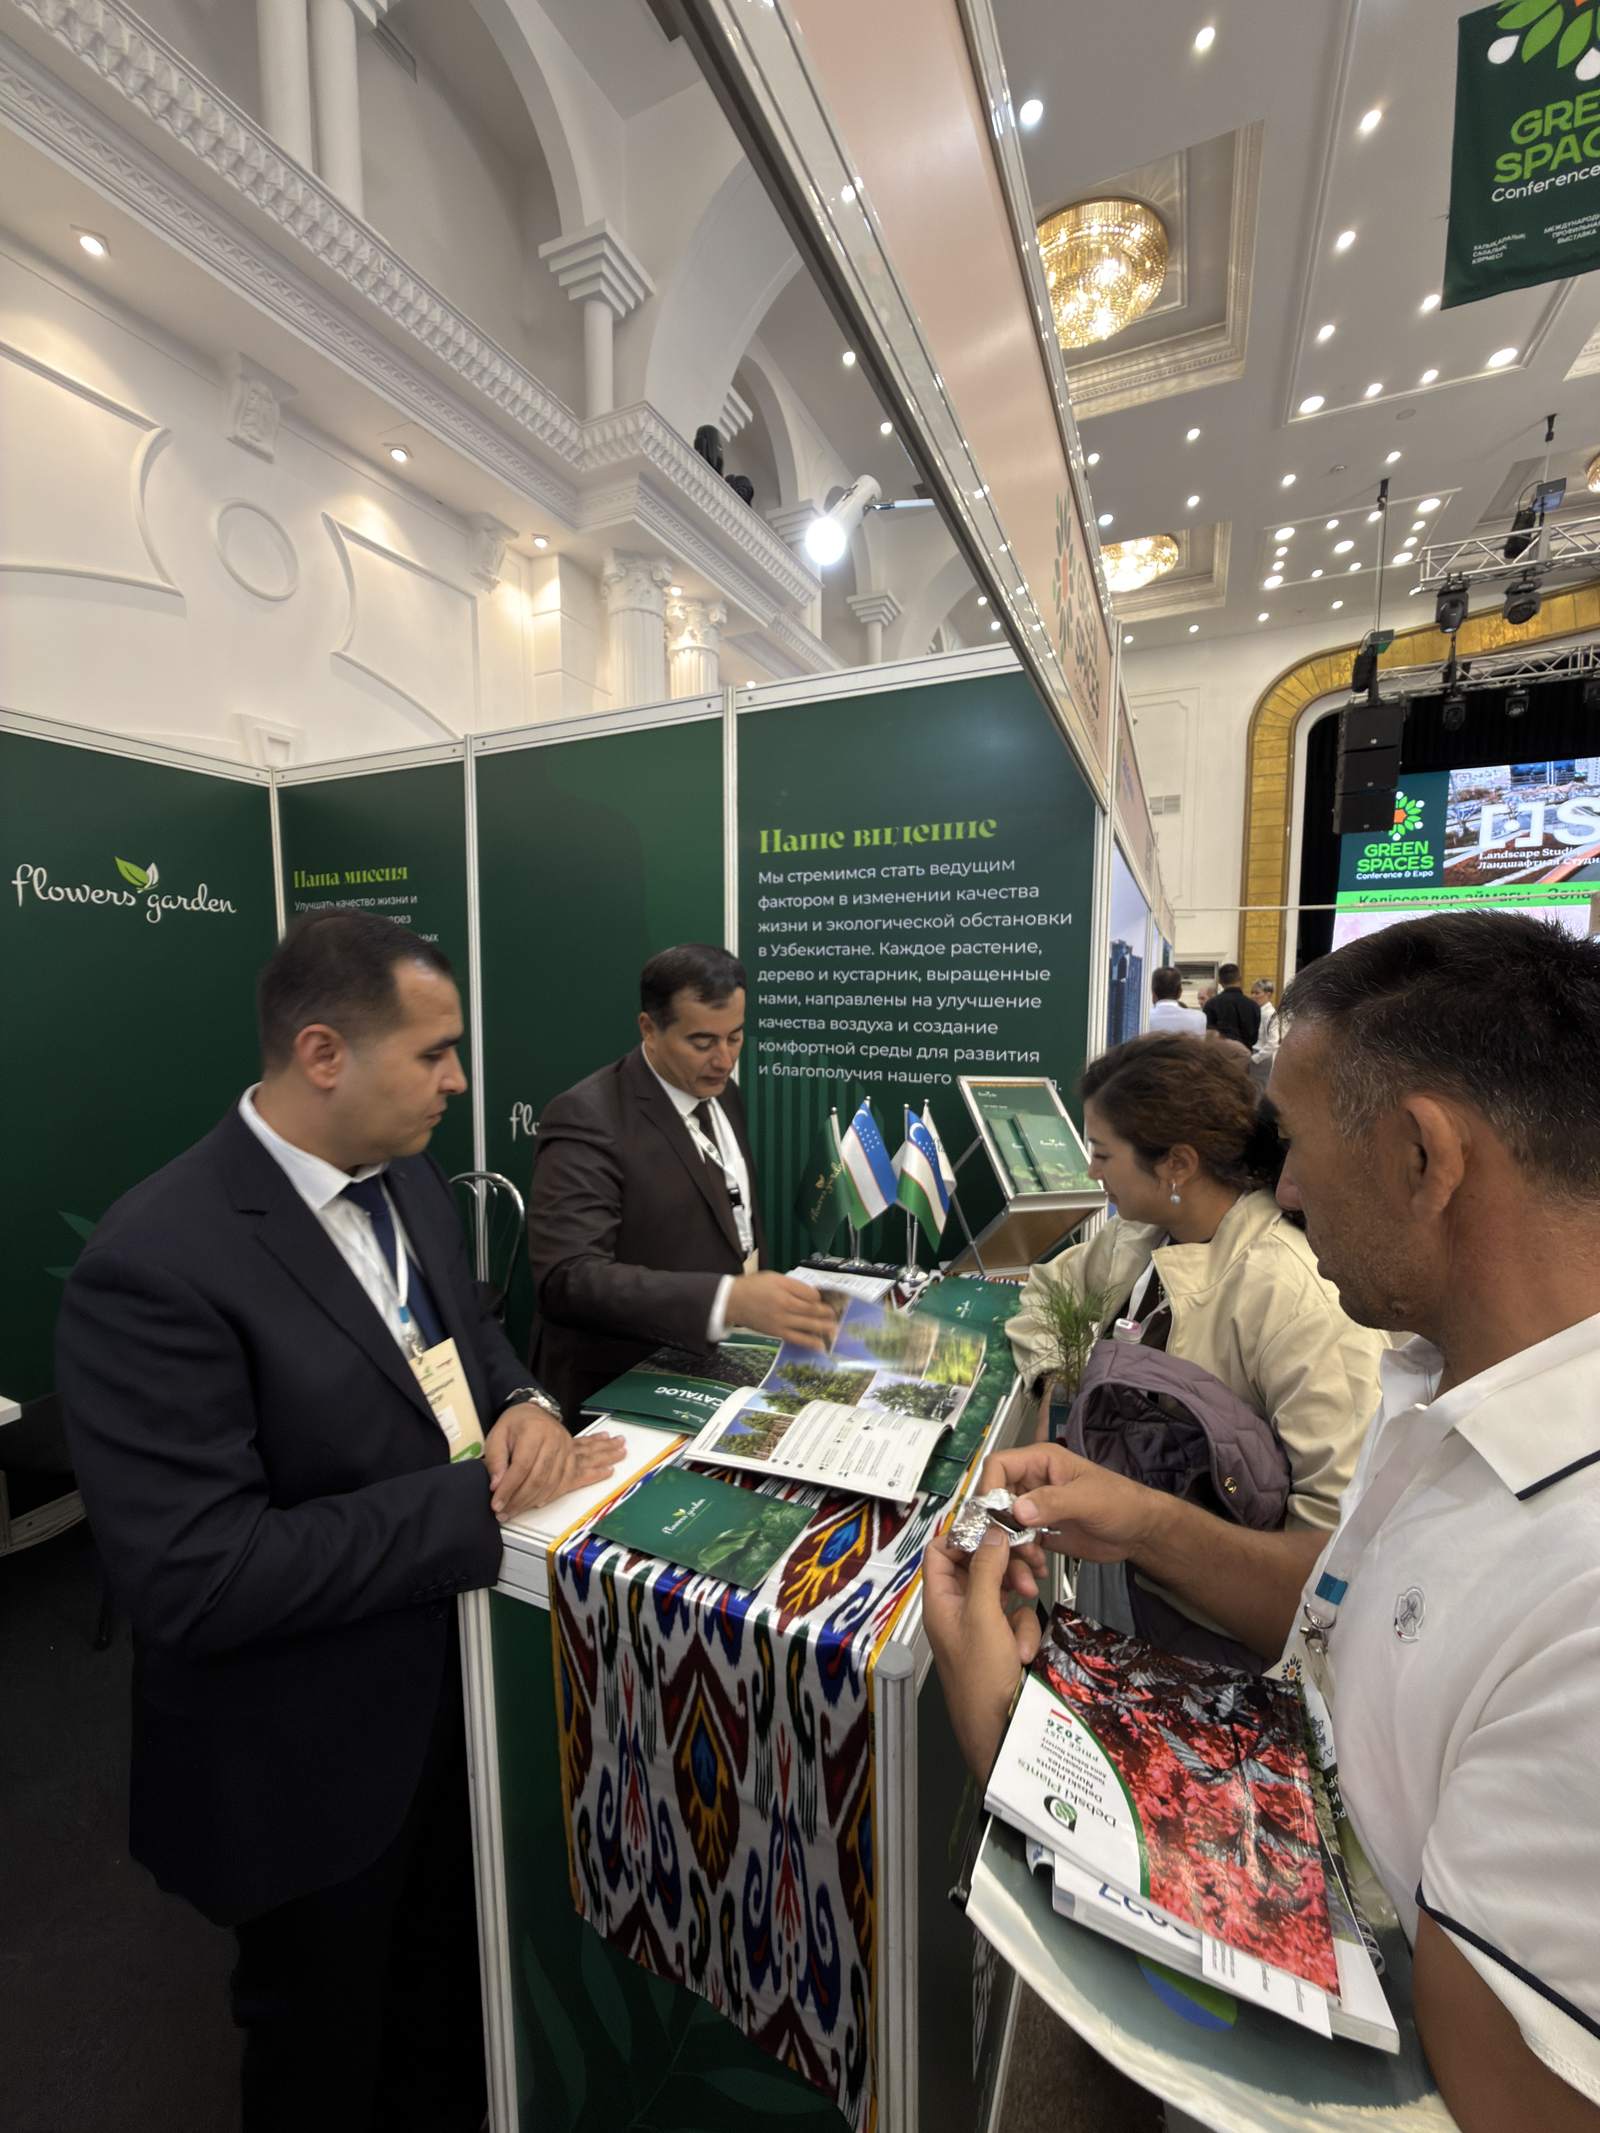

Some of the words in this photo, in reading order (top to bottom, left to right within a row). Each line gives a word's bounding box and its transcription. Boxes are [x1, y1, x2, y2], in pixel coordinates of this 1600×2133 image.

[759, 828, 845, 854] Наше
[853, 819, 997, 847] видение
[1364, 840, 1428, 857] GREEN
[1479, 850, 1540, 860] Landscape
[758, 871, 784, 885] Мы
[787, 866, 876, 885] стремимся
[880, 865, 925, 878] стать
[930, 859, 1015, 877] ведущим
[1357, 856, 1434, 872] SPACES
[294, 871, 340, 888] Наша
[345, 867, 408, 884] миссия
[1356, 872, 1402, 880] Conference
[1413, 870, 1434, 878] Expo
[11, 863, 136, 907] flowers
[146, 883, 237, 924] garden
[336, 898, 376, 908] качество
[378, 896, 409, 905] жизни
[410, 896, 418, 904] и
[758, 893, 835, 912] фактором
[839, 894, 848, 904] в
[852, 889, 951, 905] изменении
[956, 885, 1040, 901] качества
[758, 920, 808, 933] жизни
[812, 920, 822, 931] и
[826, 915, 955, 931] экологической
[960, 912, 1072, 928] обстановки
[758, 946, 767, 957] в
[771, 941, 874, 958] Узбекистане.
[880, 942, 946, 956] Каждое
[951, 940, 1042, 957] растение,
[757, 969, 814, 983] дерево
[818, 970, 829, 981] и
[832, 969, 922, 983] кустарник,
[926, 968, 1051, 983] выращенные
[758, 993, 801, 1006] нами,
[804, 994, 907, 1008] направлены
[912, 996, 933, 1007] на
[936, 995, 1042, 1010] улучшение
[758, 1018, 826, 1030] качества
[830, 1019, 893, 1033] воздуха
[898, 1021, 908, 1032] и
[913, 1021, 998, 1035] создание
[758, 1040, 855, 1056] комфортной
[859, 1044, 912, 1058] среды
[916, 1046, 948, 1059] для
[954, 1048, 1040, 1063] развития
[758, 1064, 768, 1074] и
[772, 1063, 883, 1083] благополучия
[888, 1070, 952, 1085] нашего
[654, 1386, 724, 1407] CATALOG
[1045, 1728, 1065, 1742] LIST
[1047, 1719, 1083, 1744] 2026
[1070, 1742, 1098, 1762] PRICE
[1048, 1757, 1094, 1789] Nurseries
